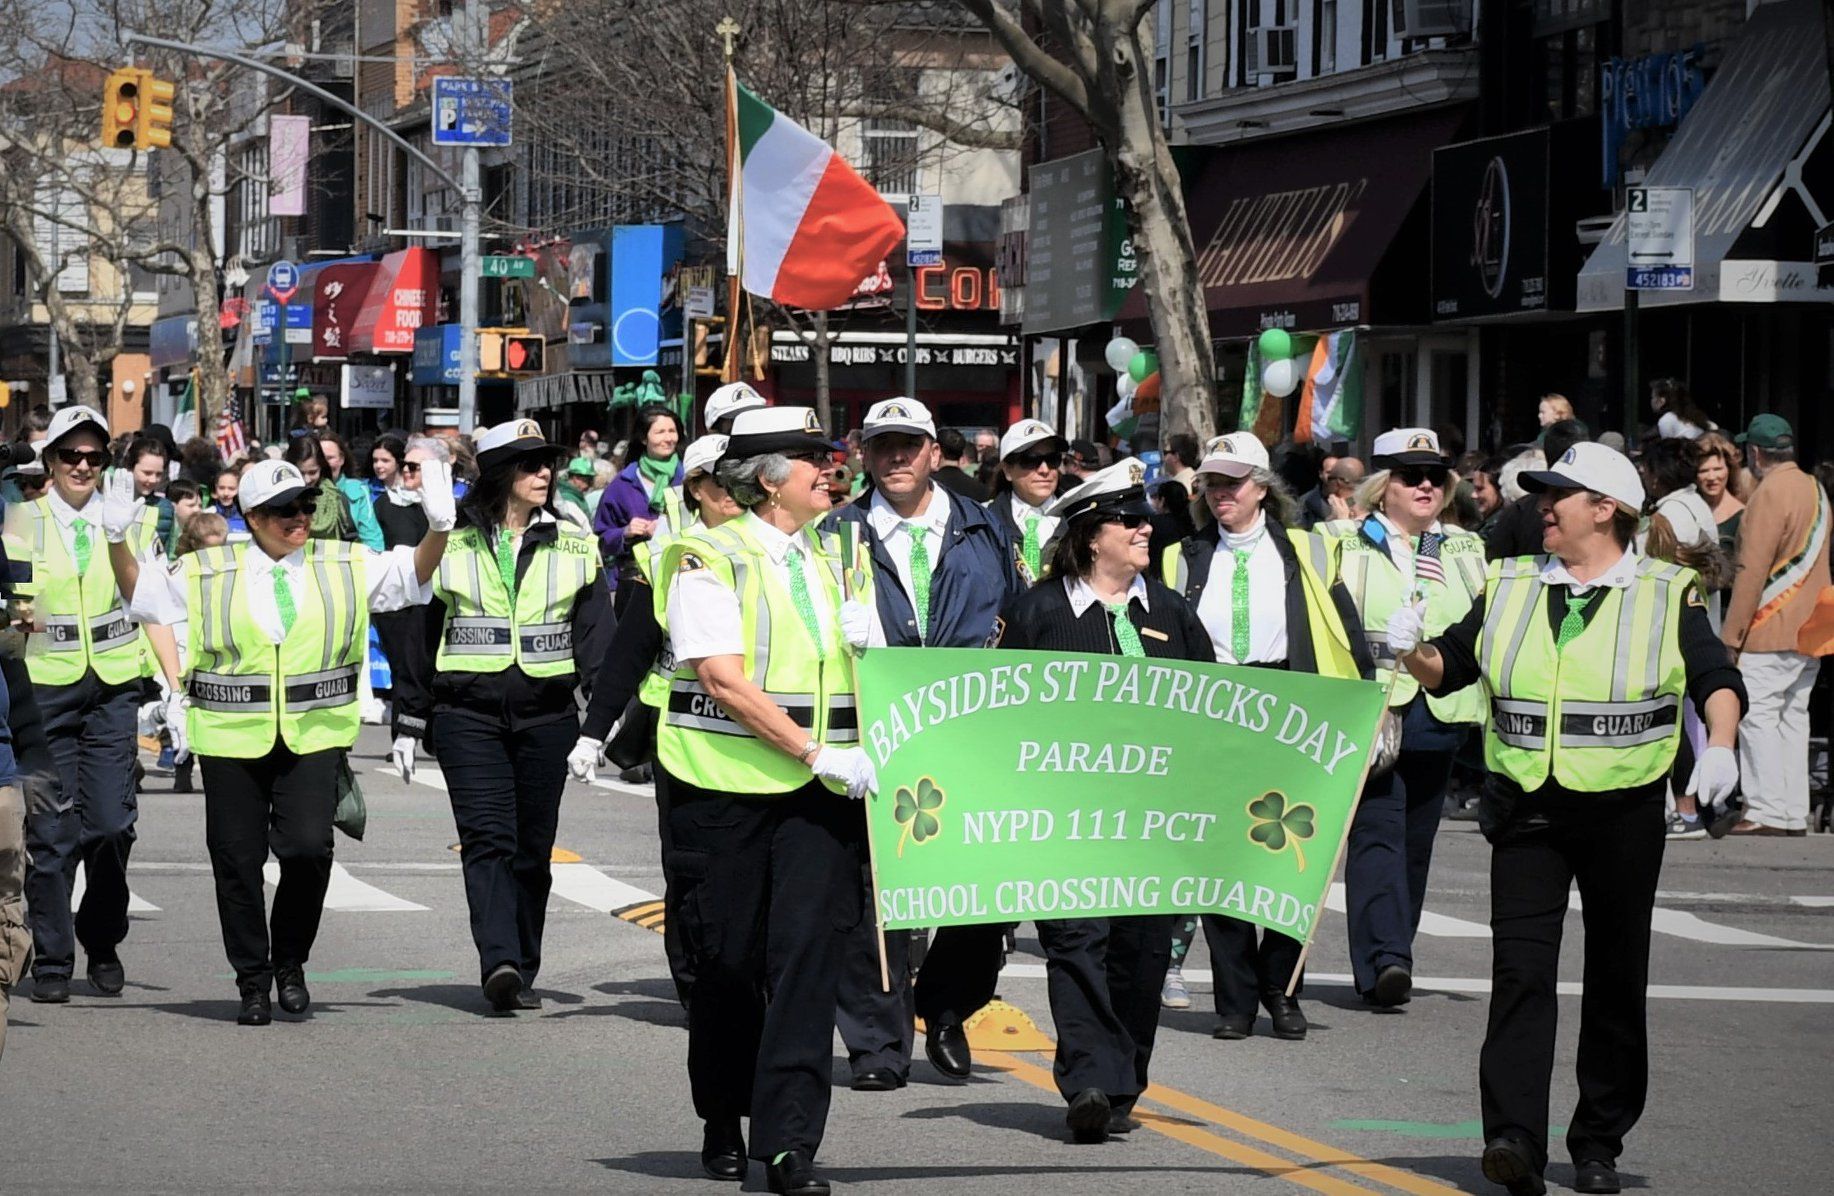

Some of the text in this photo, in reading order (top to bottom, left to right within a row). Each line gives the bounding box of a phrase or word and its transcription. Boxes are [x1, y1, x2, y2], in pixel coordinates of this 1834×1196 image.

[911, 196, 919, 212] 2
[1632, 191, 1643, 211] 2
[490, 259, 508, 275] 40
[394, 289, 425, 308] CHINESE
[396, 310, 423, 329] FOOD
[772, 345, 810, 361] STEAKS
[831, 346, 851, 363] BBQ
[852, 347, 876, 363] RIBS
[952, 349, 998, 365] BURGERS
[195, 678, 349, 702] CROSSING GUARD
[867, 660, 1359, 776] BAYSIDES ST PATRICKS DAY
[1592, 713, 1655, 735] GUARD
[1016, 740, 1173, 776] PARADE
[961, 808, 1217, 844] NYPD 111 PCT
[880, 875, 1316, 936] SCHOOL CROSSING GUARDS
